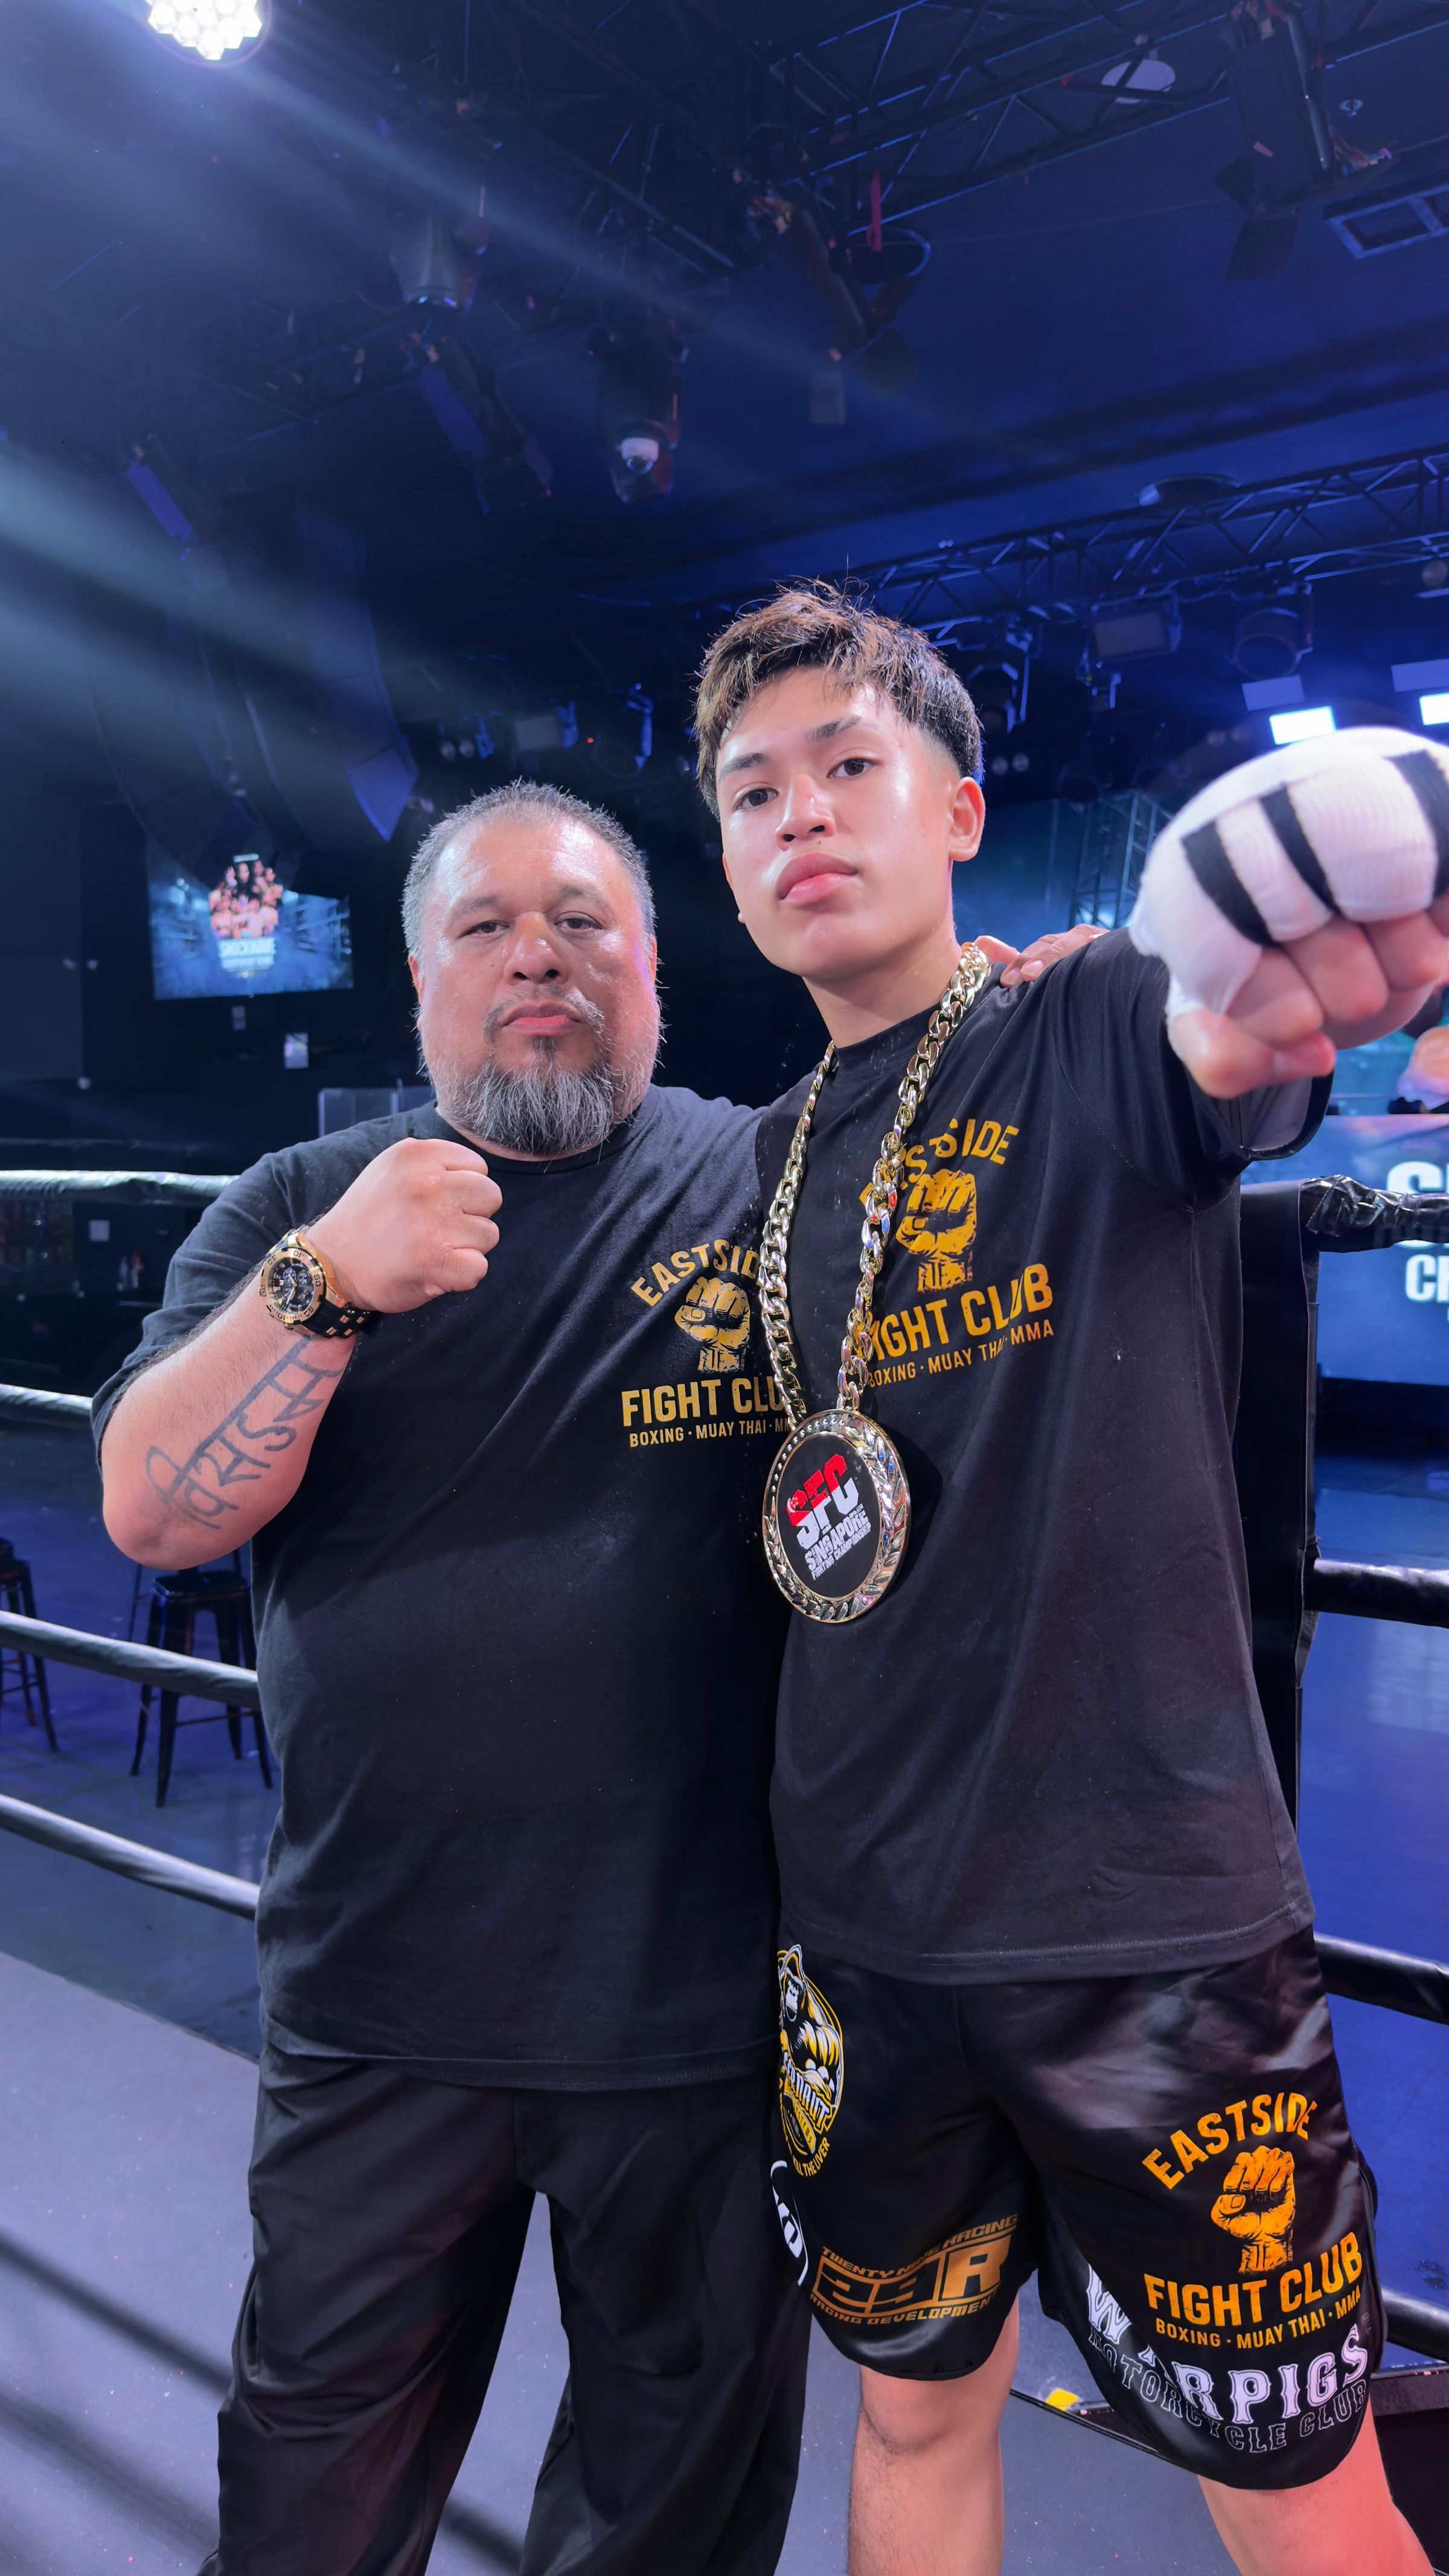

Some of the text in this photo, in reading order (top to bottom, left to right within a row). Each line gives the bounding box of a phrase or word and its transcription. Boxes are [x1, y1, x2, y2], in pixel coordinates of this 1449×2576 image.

[631, 1239, 761, 1307] EASTSID
[961, 1263, 1053, 1336] CLUB
[927, 1349, 972, 1374] MUAY
[1010, 1318, 1054, 1344] MMA
[621, 1376, 785, 1427] FIGHT CLU
[629, 1427, 684, 1448] BOXING
[696, 1422, 734, 1439] MUAY
[738, 1419, 766, 1434] THAI
[805, 1503, 869, 1571] SINGAPORE
[833, 1521, 872, 1561] CHAMPIONSHIP
[803, 2159, 817, 2177] THE
[813, 2137, 830, 2171] LIVER
[1142, 2092, 1318, 2190] EASTSIDE
[823, 2245, 894, 2279] TWENTY
[942, 2212, 1019, 2250] RACING
[810, 2292, 863, 2325] RACING
[1144, 2232, 1363, 2327] FIGHT CLUB
[1156, 2318, 1221, 2347] BOXING
[1237, 2328, 1284, 2348] MUAY
[1288, 2309, 1326, 2339] THAI
[1335, 2284, 1361, 2319] MMA
[1299, 2379, 1366, 2438] CLUB
